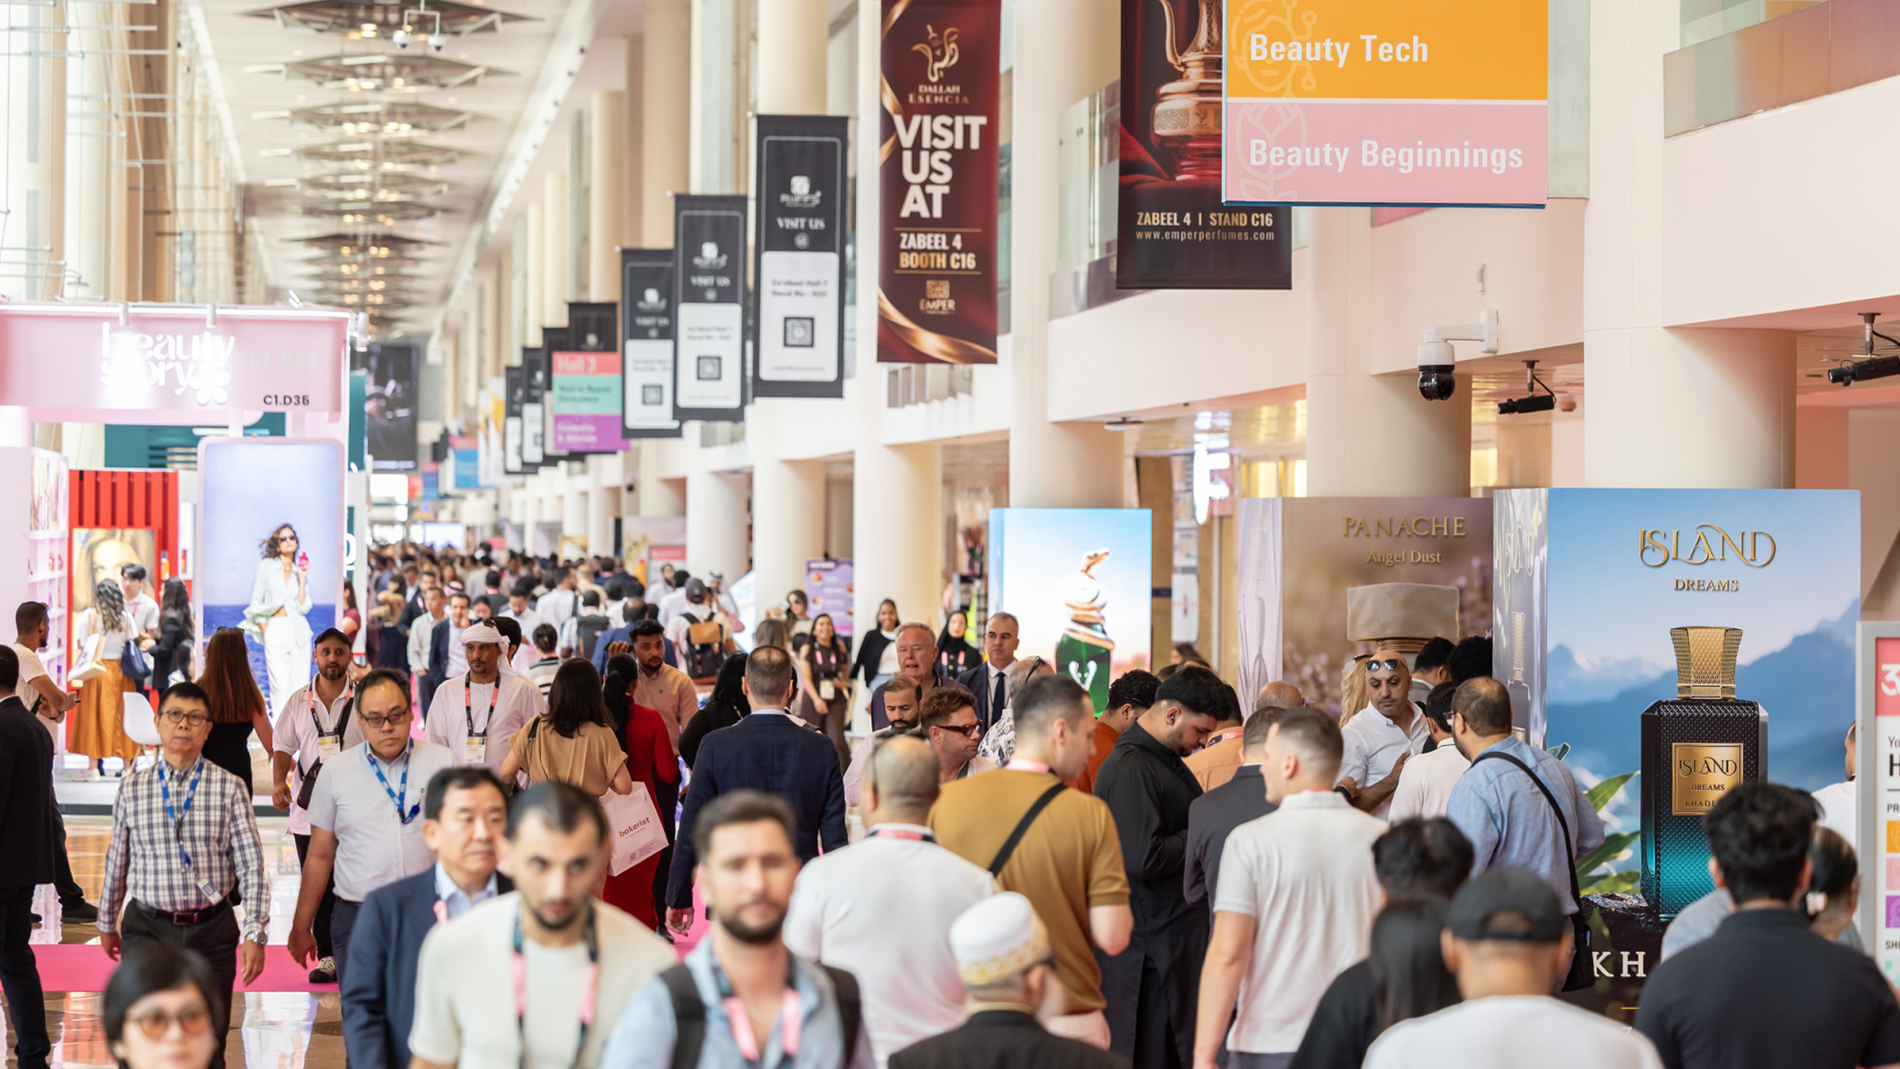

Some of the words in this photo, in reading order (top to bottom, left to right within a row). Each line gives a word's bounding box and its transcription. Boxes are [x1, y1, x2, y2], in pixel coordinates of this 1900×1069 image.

[1250, 33, 1350, 68] Beauty
[1360, 34, 1428, 62] Tech
[918, 84, 961, 94] DALLAH
[892, 114, 987, 150] VISIT
[1250, 139, 1349, 173] Beauty
[1361, 139, 1523, 174] Beginnings
[902, 150, 953, 184] US
[899, 184, 950, 218] AT
[776, 216, 807, 231] VISIT
[808, 216, 826, 231] US
[1136, 212, 1180, 226] ZABEEL
[1183, 212, 1192, 226] 4
[1209, 212, 1248, 227] STAND
[1251, 213, 1273, 227] C16
[899, 232, 950, 250] ZABEEL
[951, 233, 963, 250] 4
[1136, 229, 1275, 242] www.emperperfumes.com
[899, 251, 947, 269] BOOTH
[949, 252, 976, 270] C16
[918, 298, 956, 311] EMPER
[557, 355, 585, 373] Hall
[1343, 516, 1466, 537] PANACHE
[1637, 522, 1777, 568] ISLAND
[1367, 550, 1406, 566] Angel
[1410, 550, 1442, 563] Dust
[1674, 578, 1739, 591] DREAMS
[1679, 756, 1738, 777] ISLAND
[1690, 783, 1725, 792] DREAMS
[618, 817, 651, 838] bakerist
